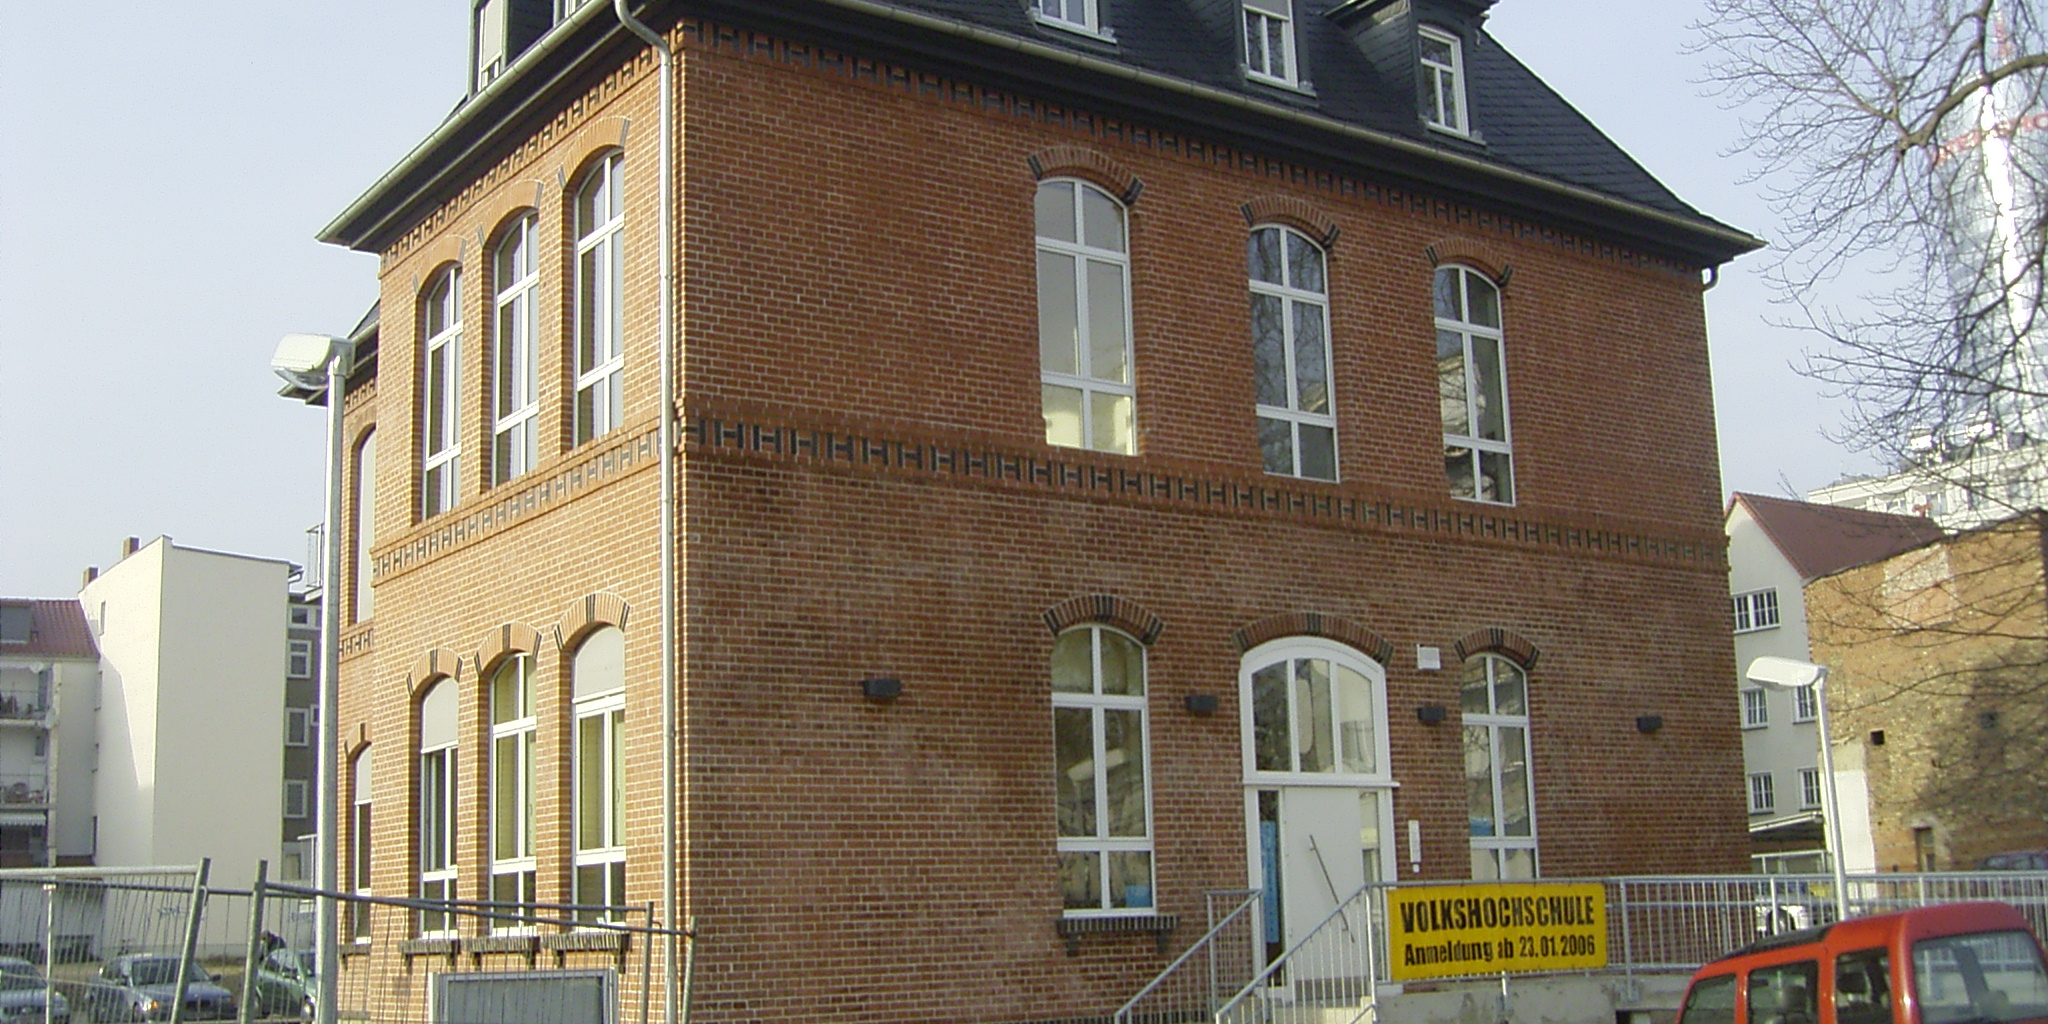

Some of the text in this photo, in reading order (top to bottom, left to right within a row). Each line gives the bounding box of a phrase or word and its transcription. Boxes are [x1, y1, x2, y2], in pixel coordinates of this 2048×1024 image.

[1400, 896, 1594, 933] VOLKSHOCHSCHULE
[1405, 935, 1595, 966] Anmeldung ab 23.01.2006
